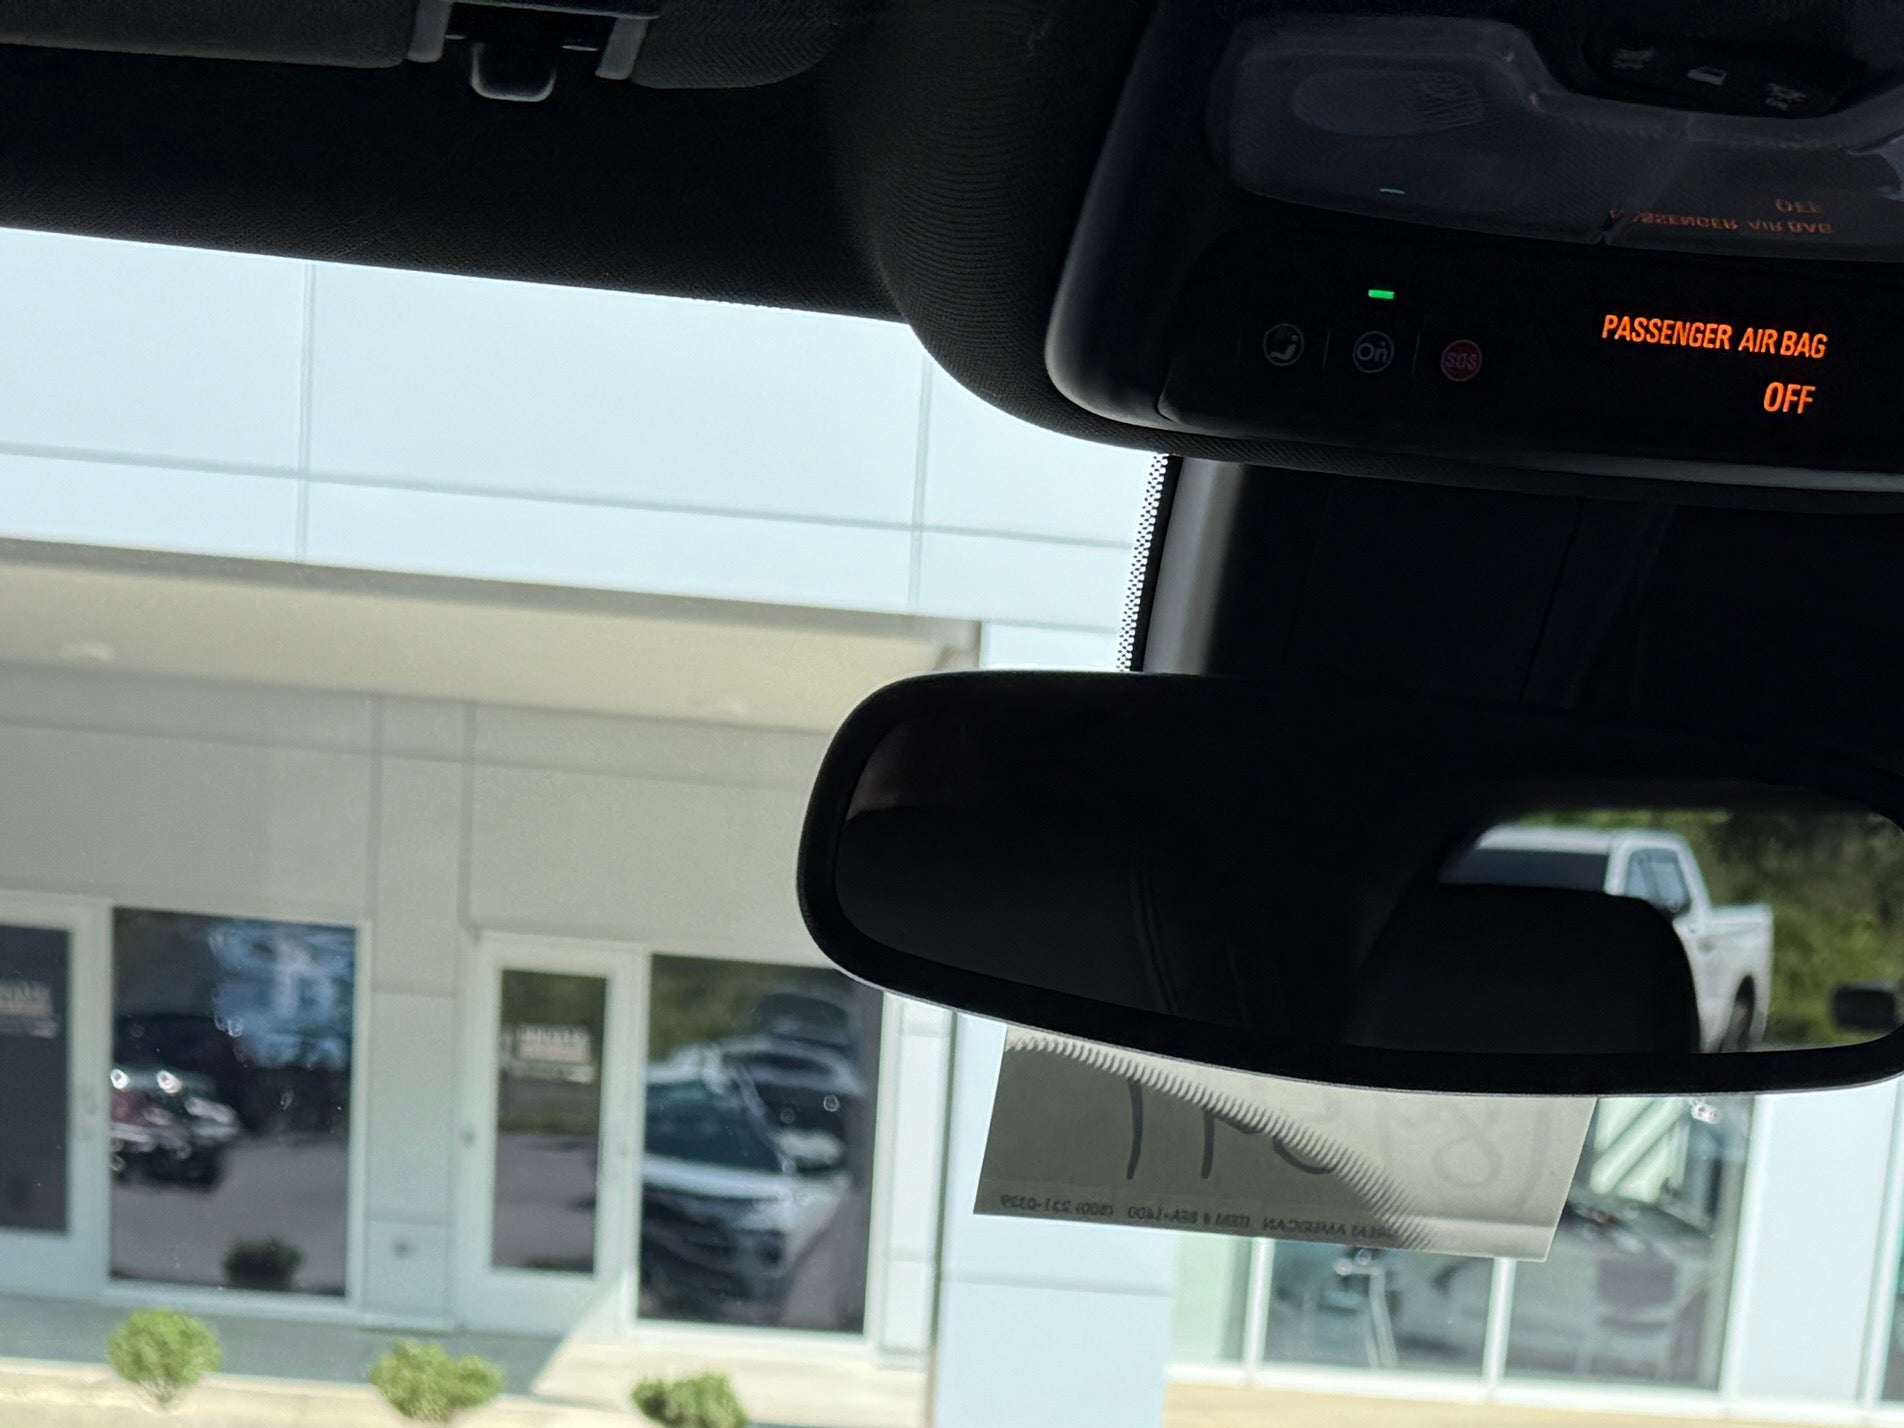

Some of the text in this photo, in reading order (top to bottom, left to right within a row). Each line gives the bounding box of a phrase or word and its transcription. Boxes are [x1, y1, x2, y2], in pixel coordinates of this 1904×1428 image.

[1601, 313, 1829, 360] PASSENGER AIR BAG
[1446, 351, 1479, 370] SOS
[1763, 380, 1818, 415] OFF
